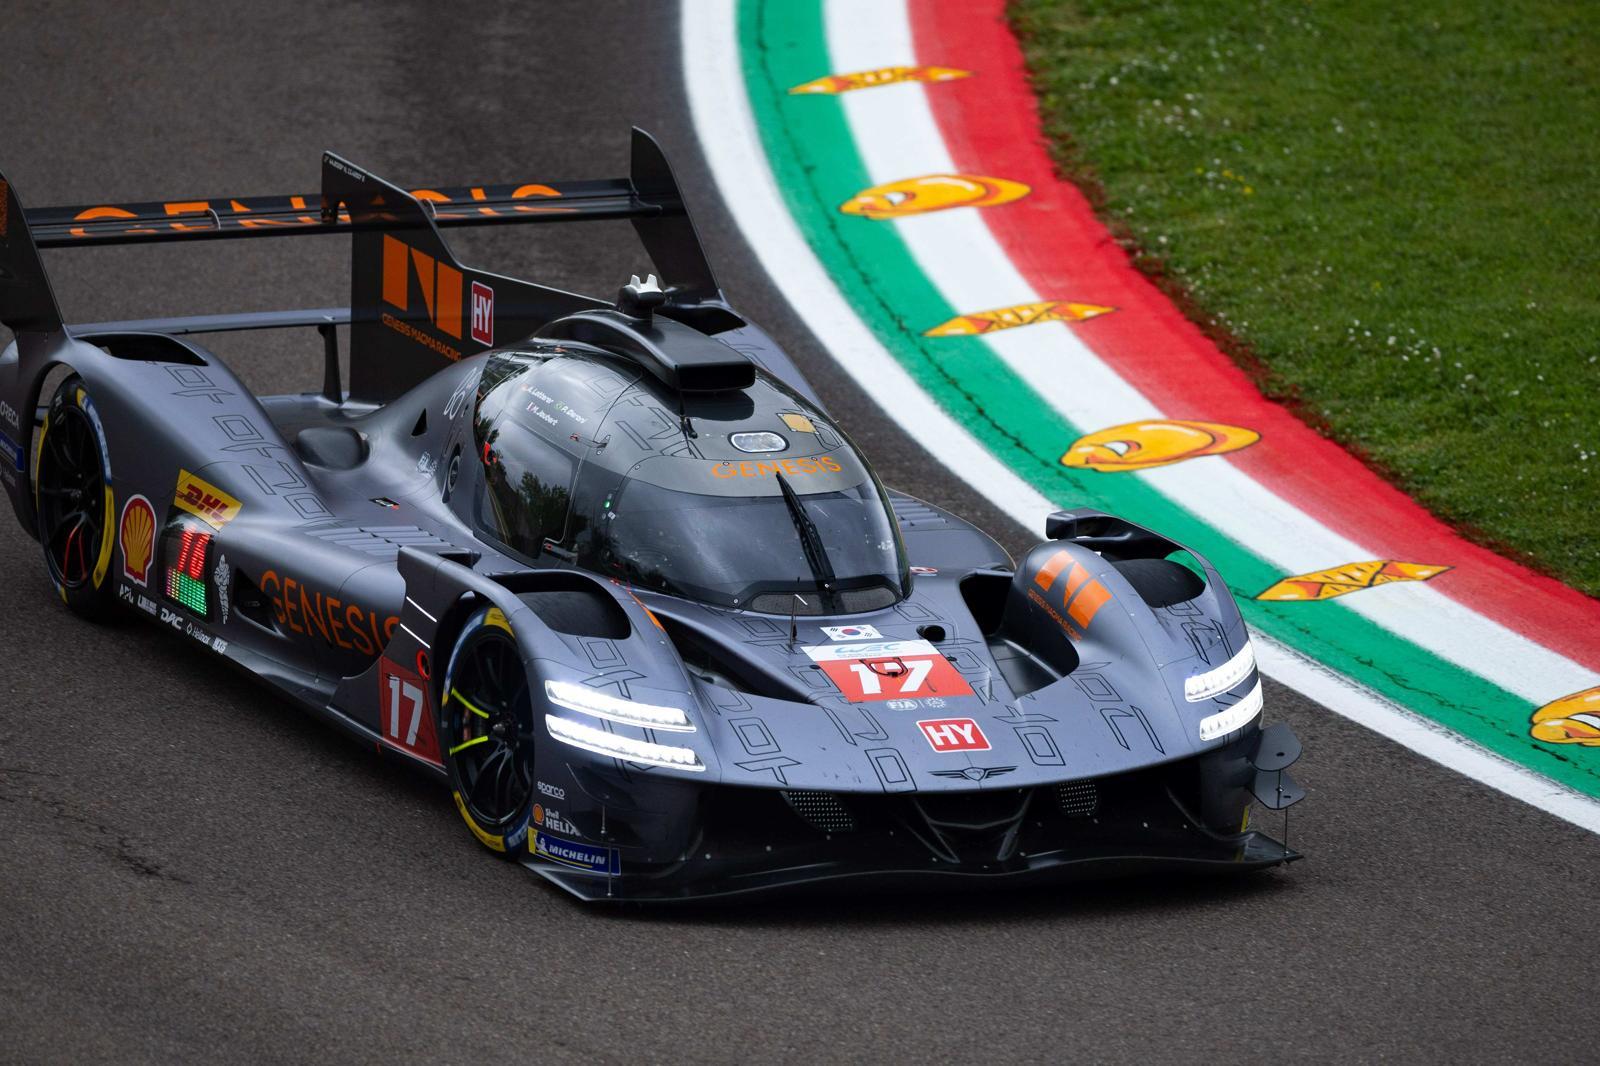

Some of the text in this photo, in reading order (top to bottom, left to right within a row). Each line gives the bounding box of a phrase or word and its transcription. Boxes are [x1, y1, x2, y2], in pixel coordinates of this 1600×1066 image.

[473, 294, 491, 334] HY
[383, 313, 462, 362] GENESIS MAGMA RACING
[711, 456, 841, 480] GENESIS
[184, 483, 228, 520] DHL
[160, 608, 184, 630] DAC
[835, 643, 901, 655] WEC
[850, 660, 933, 694] 17
[389, 675, 423, 746] 17
[891, 700, 916, 710] FIA
[925, 723, 976, 745] HY
[537, 781, 565, 799] sparco
[545, 808, 560, 819] Shell
[546, 817, 581, 837] HELIX
[549, 844, 606, 865] MICHELIN
